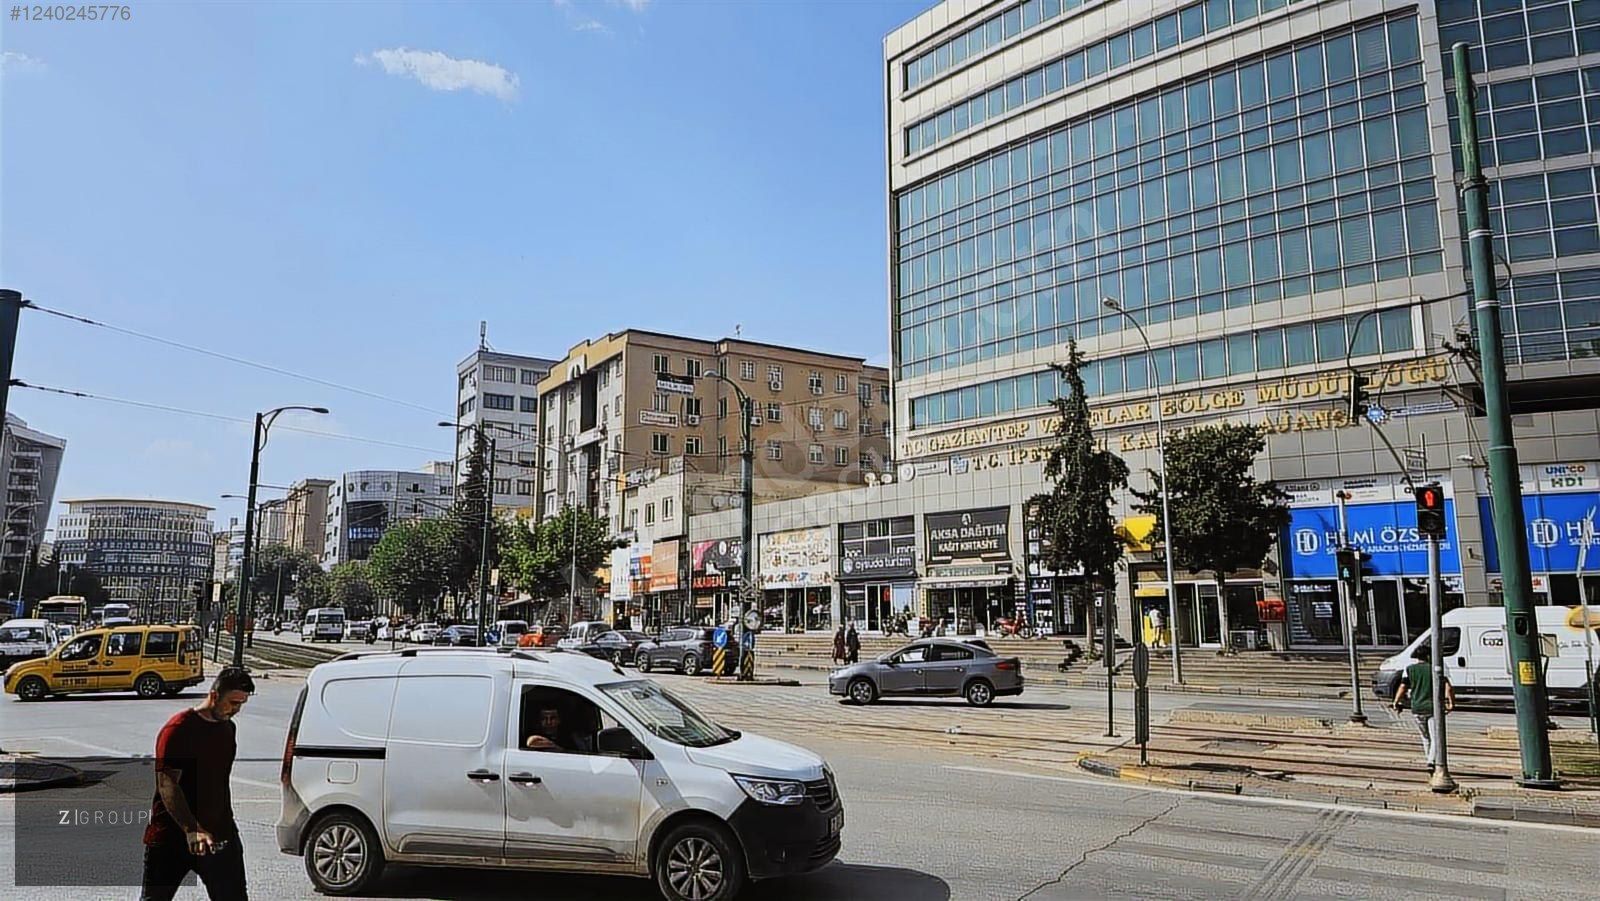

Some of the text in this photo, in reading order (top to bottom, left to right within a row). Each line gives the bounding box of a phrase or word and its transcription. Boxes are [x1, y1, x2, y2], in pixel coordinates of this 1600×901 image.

[929, 422, 1029, 451] GAZİANTEP
[1162, 389, 1246, 417] BÖLGE
[972, 454, 1003, 470] T.C.
[931, 523, 1006, 540] AKSA DAĞITIM
